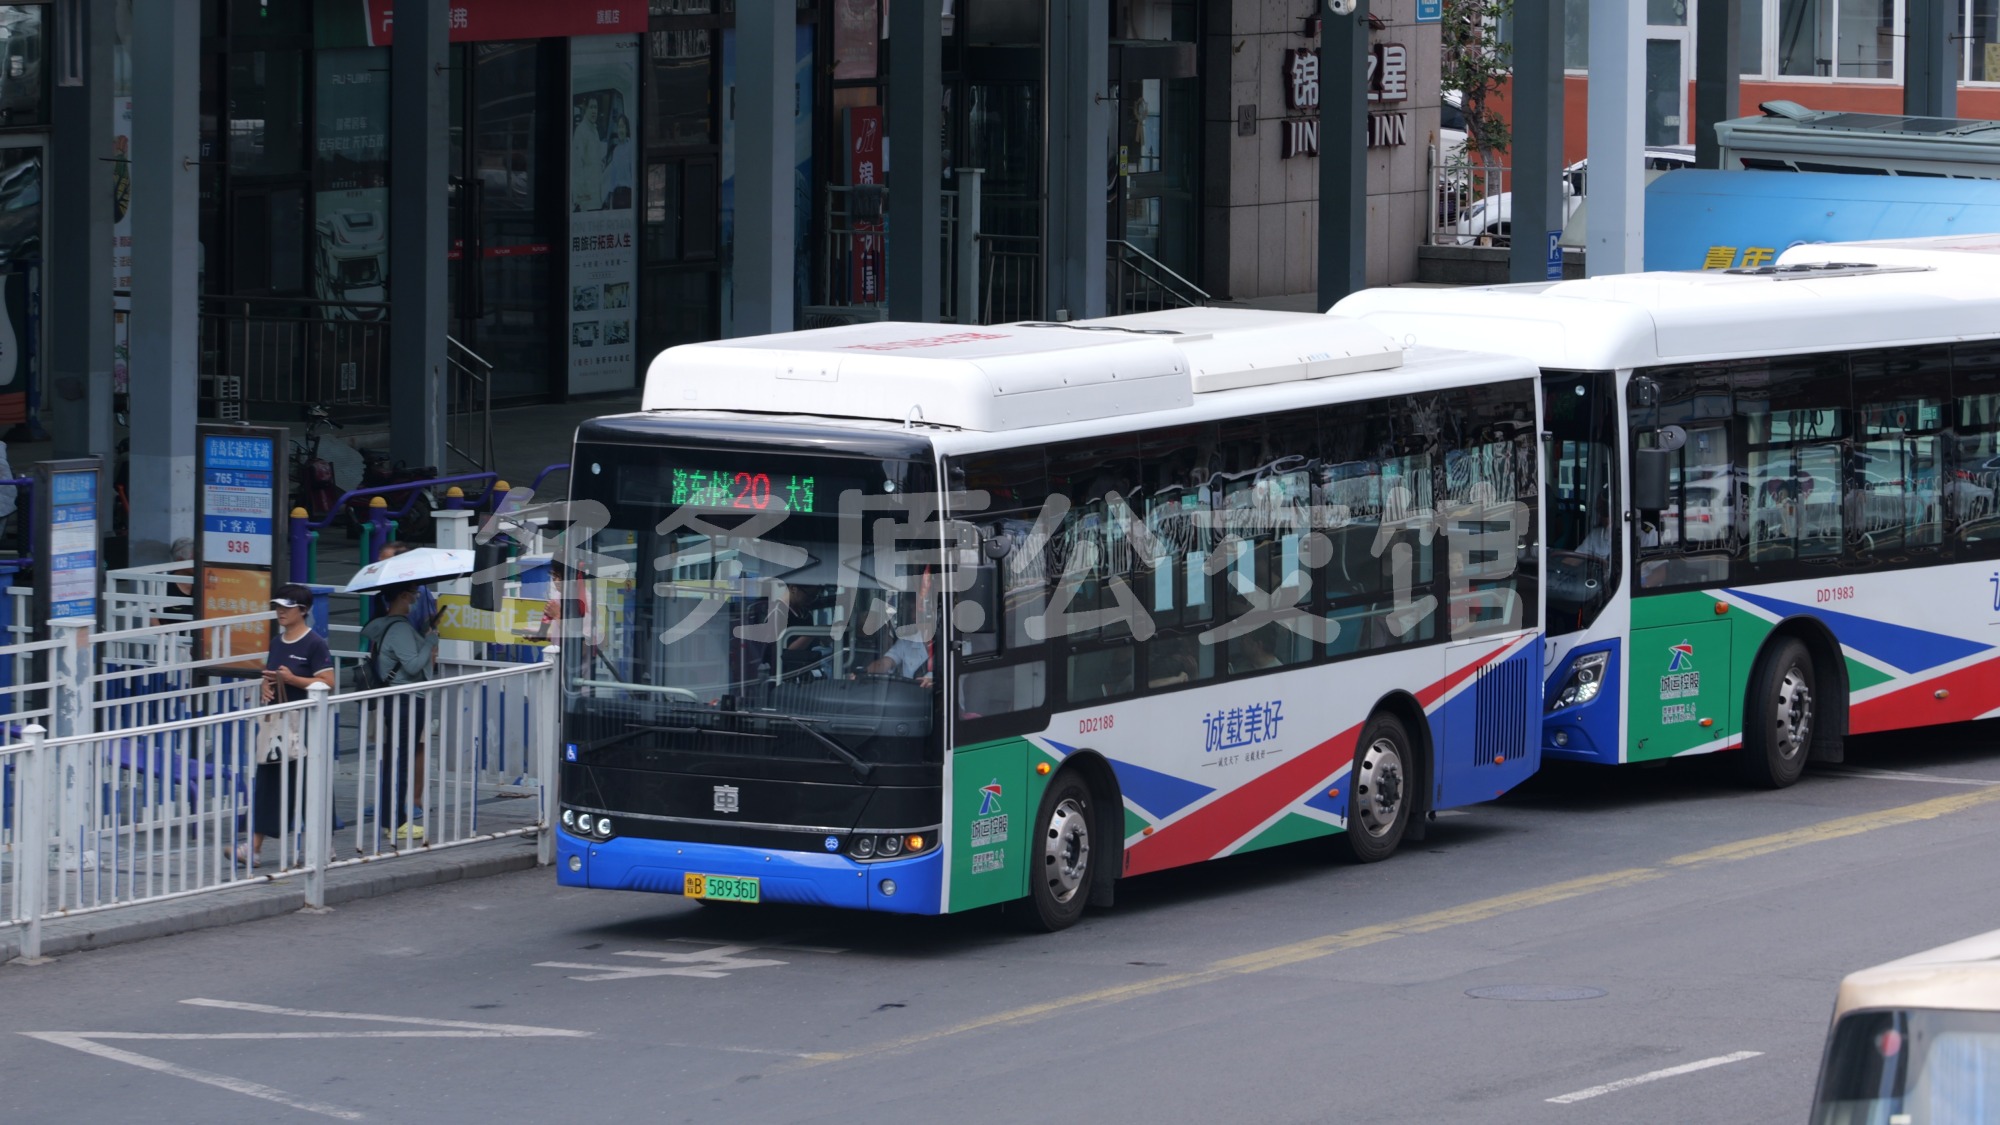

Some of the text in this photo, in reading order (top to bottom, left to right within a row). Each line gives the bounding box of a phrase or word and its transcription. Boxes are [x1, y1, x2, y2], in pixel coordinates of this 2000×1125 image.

[596, 10, 620, 24] 旗舰店
[1292, 46, 1407, 107] 锦之星
[1375, 114, 1407, 146] INN
[572, 233, 632, 252] 用旅行拓宽人生
[210, 440, 269, 459] 青岛长途汽车站
[215, 473, 232, 484] 765
[733, 472, 770, 510] 20
[217, 519, 256, 533] 下客站
[228, 540, 249, 553] 936
[1816, 586, 1855, 603] DD1983
[1660, 672, 1699, 692] 城运控股
[1079, 714, 1114, 734] DD2188
[1203, 700, 1284, 752] 诚载美好
[972, 815, 1008, 838] 城运控股
